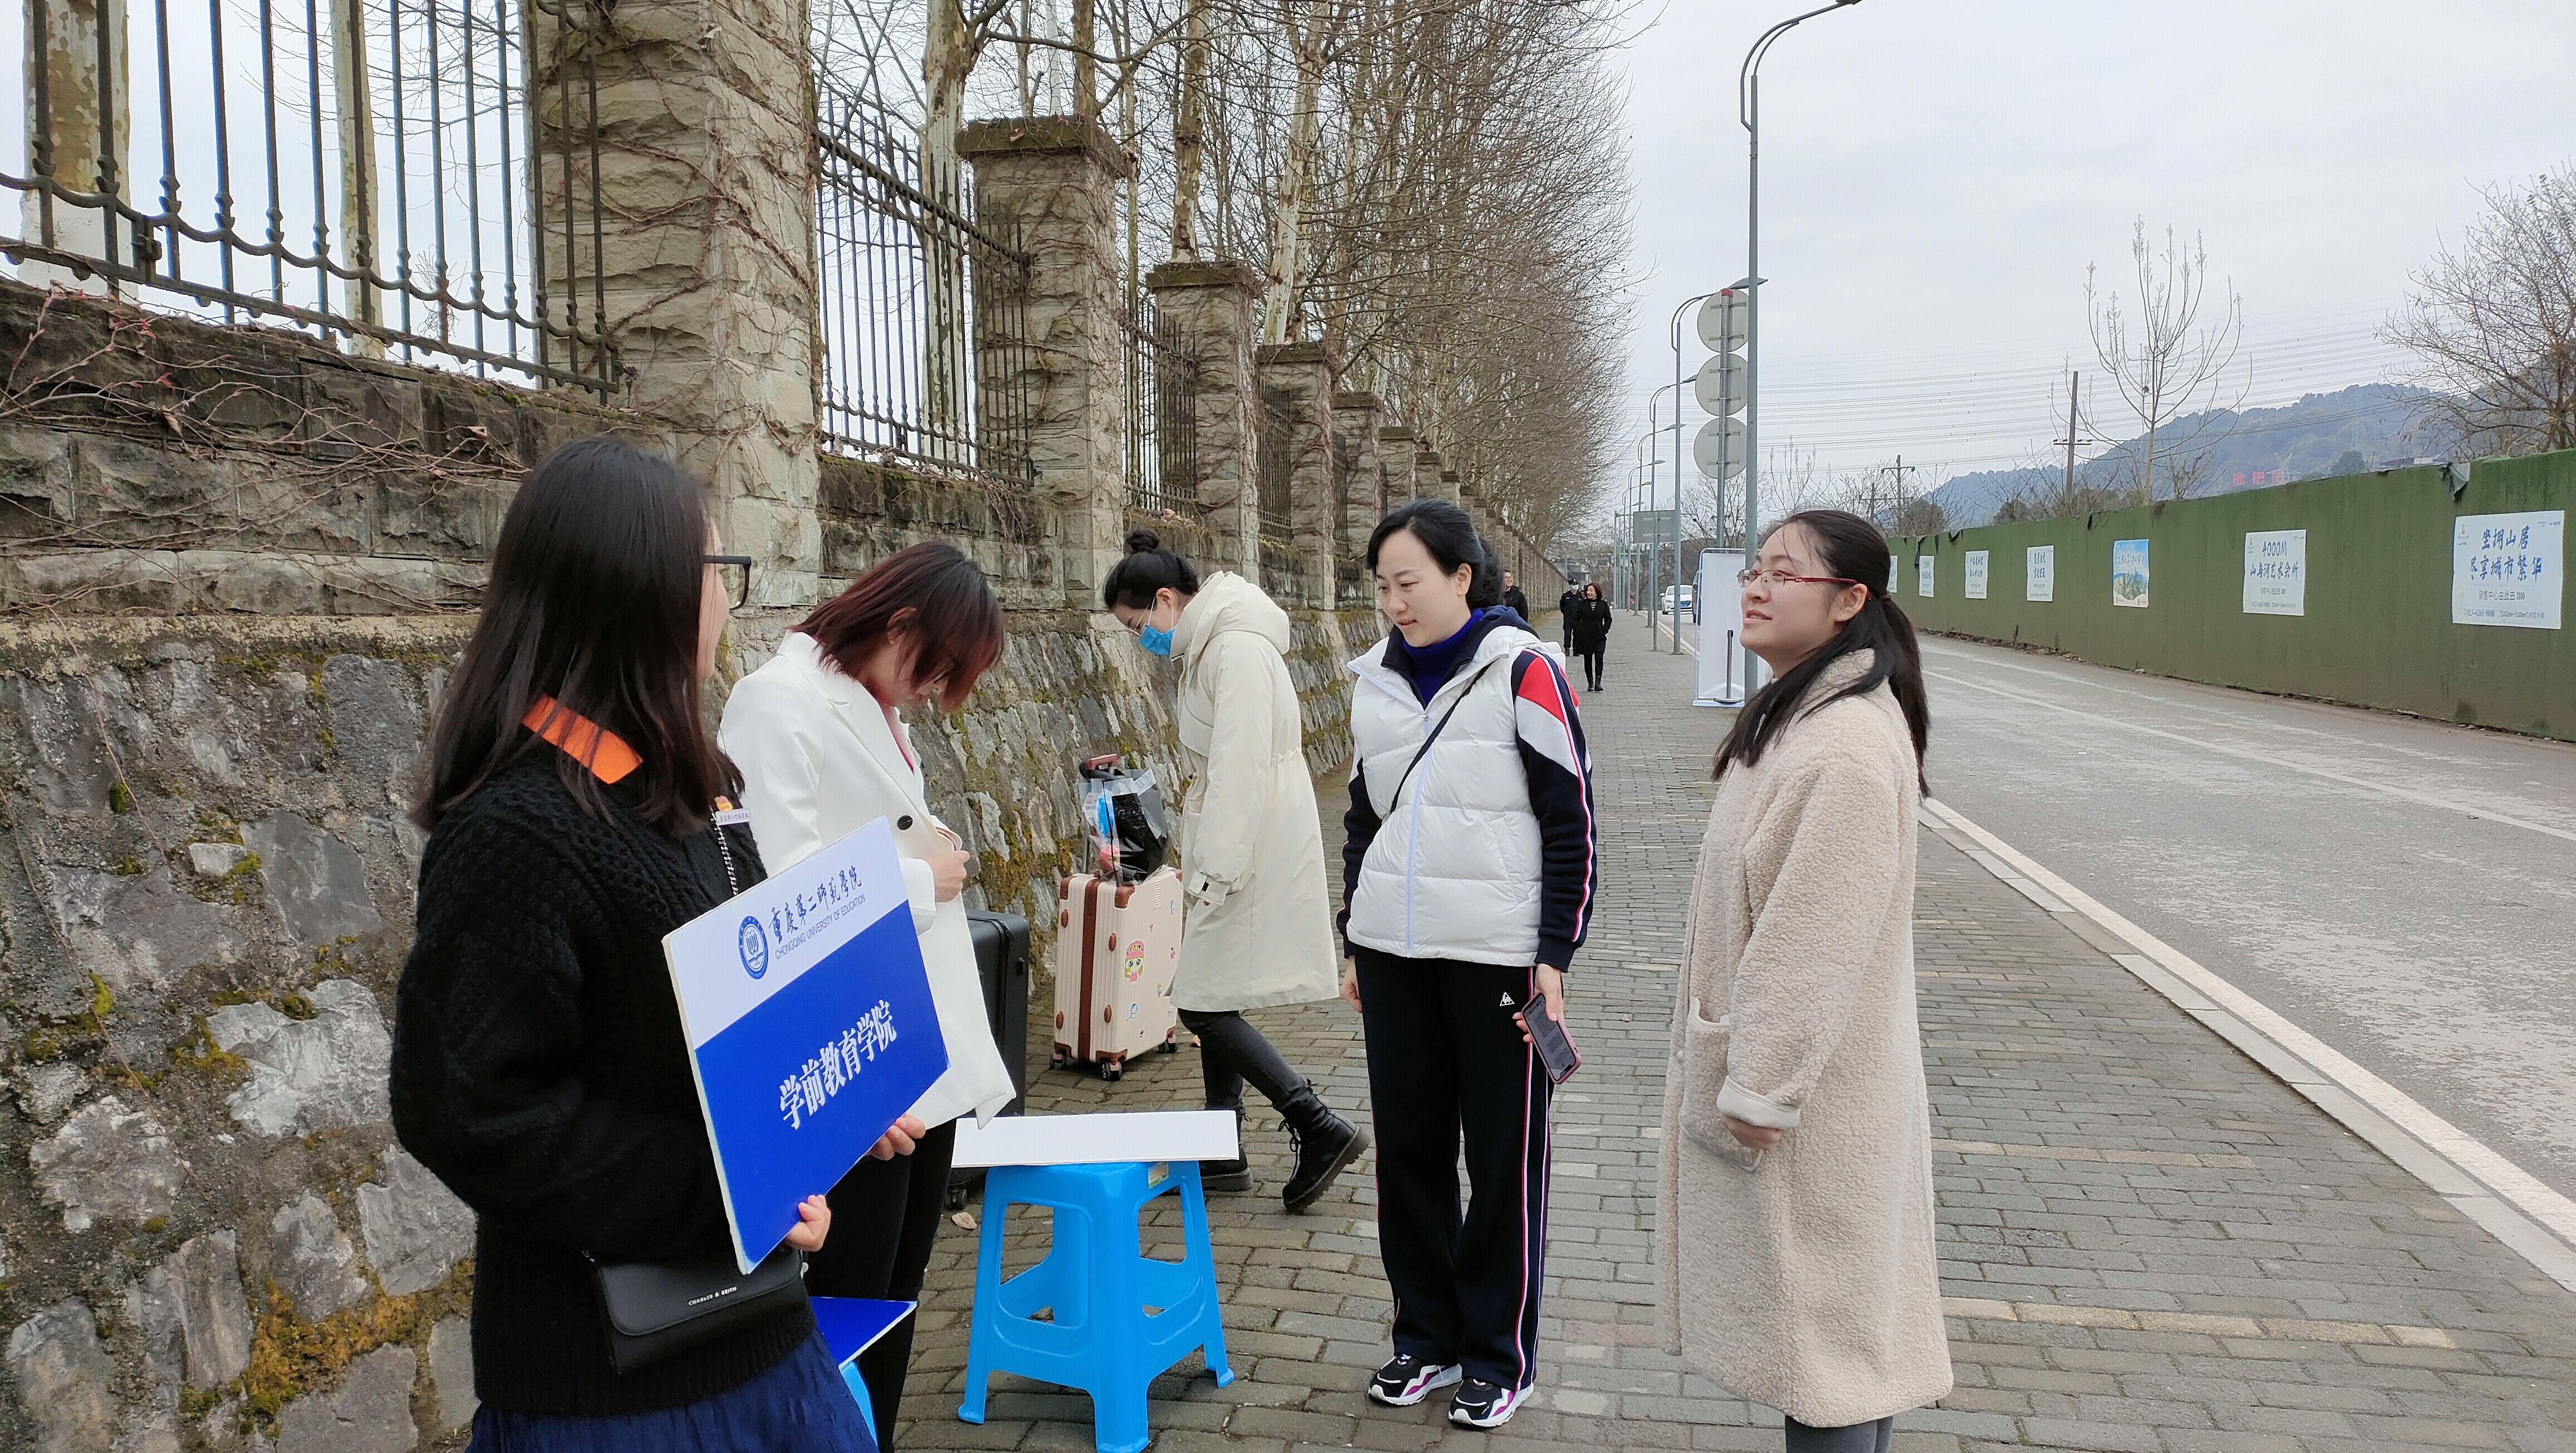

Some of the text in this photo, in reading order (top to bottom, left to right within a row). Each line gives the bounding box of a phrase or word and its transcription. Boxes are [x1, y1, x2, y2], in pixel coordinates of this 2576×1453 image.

[2468, 553, 2542, 583] 尽享城市繁华
[2479, 591, 2515, 601] 销售中心由此去
[775, 894, 866, 959] CHONGQING UNIVERSITY OF EDUCATION
[779, 999, 897, 1130] 学前教育学院
[688, 1294, 713, 1305] CHARLES
[721, 1286, 737, 1295] KEITH
